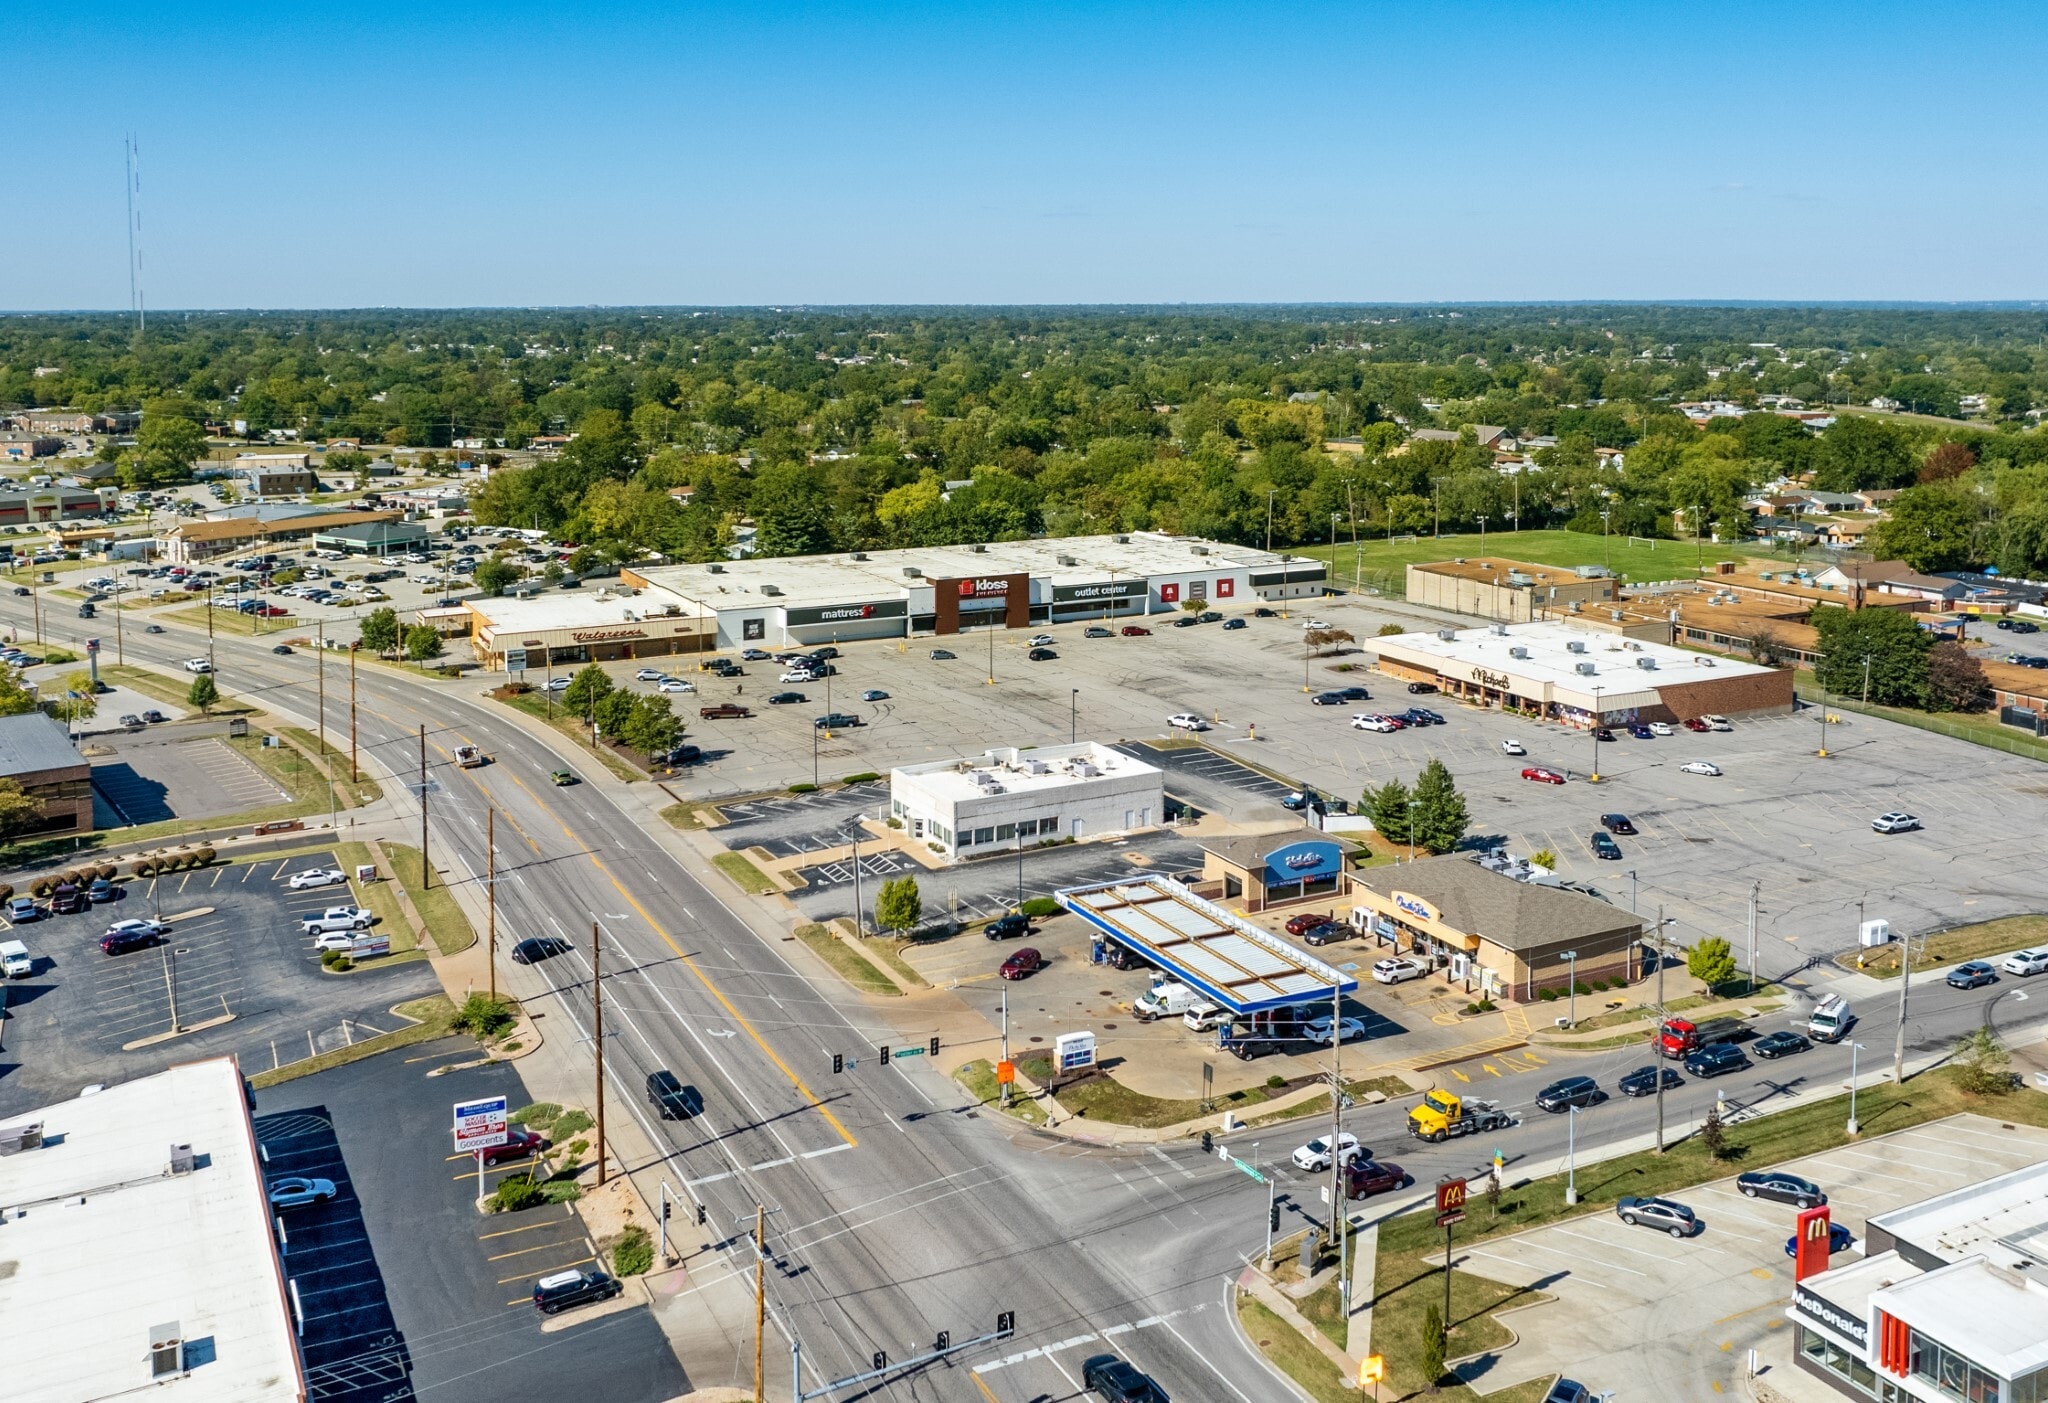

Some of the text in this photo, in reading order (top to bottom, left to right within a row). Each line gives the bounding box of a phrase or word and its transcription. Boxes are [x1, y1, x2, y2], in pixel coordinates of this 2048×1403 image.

[976, 579, 1008, 591] kloss
[1075, 586, 1127, 597] outlet center
[571, 629, 643, 641] Walgreens
